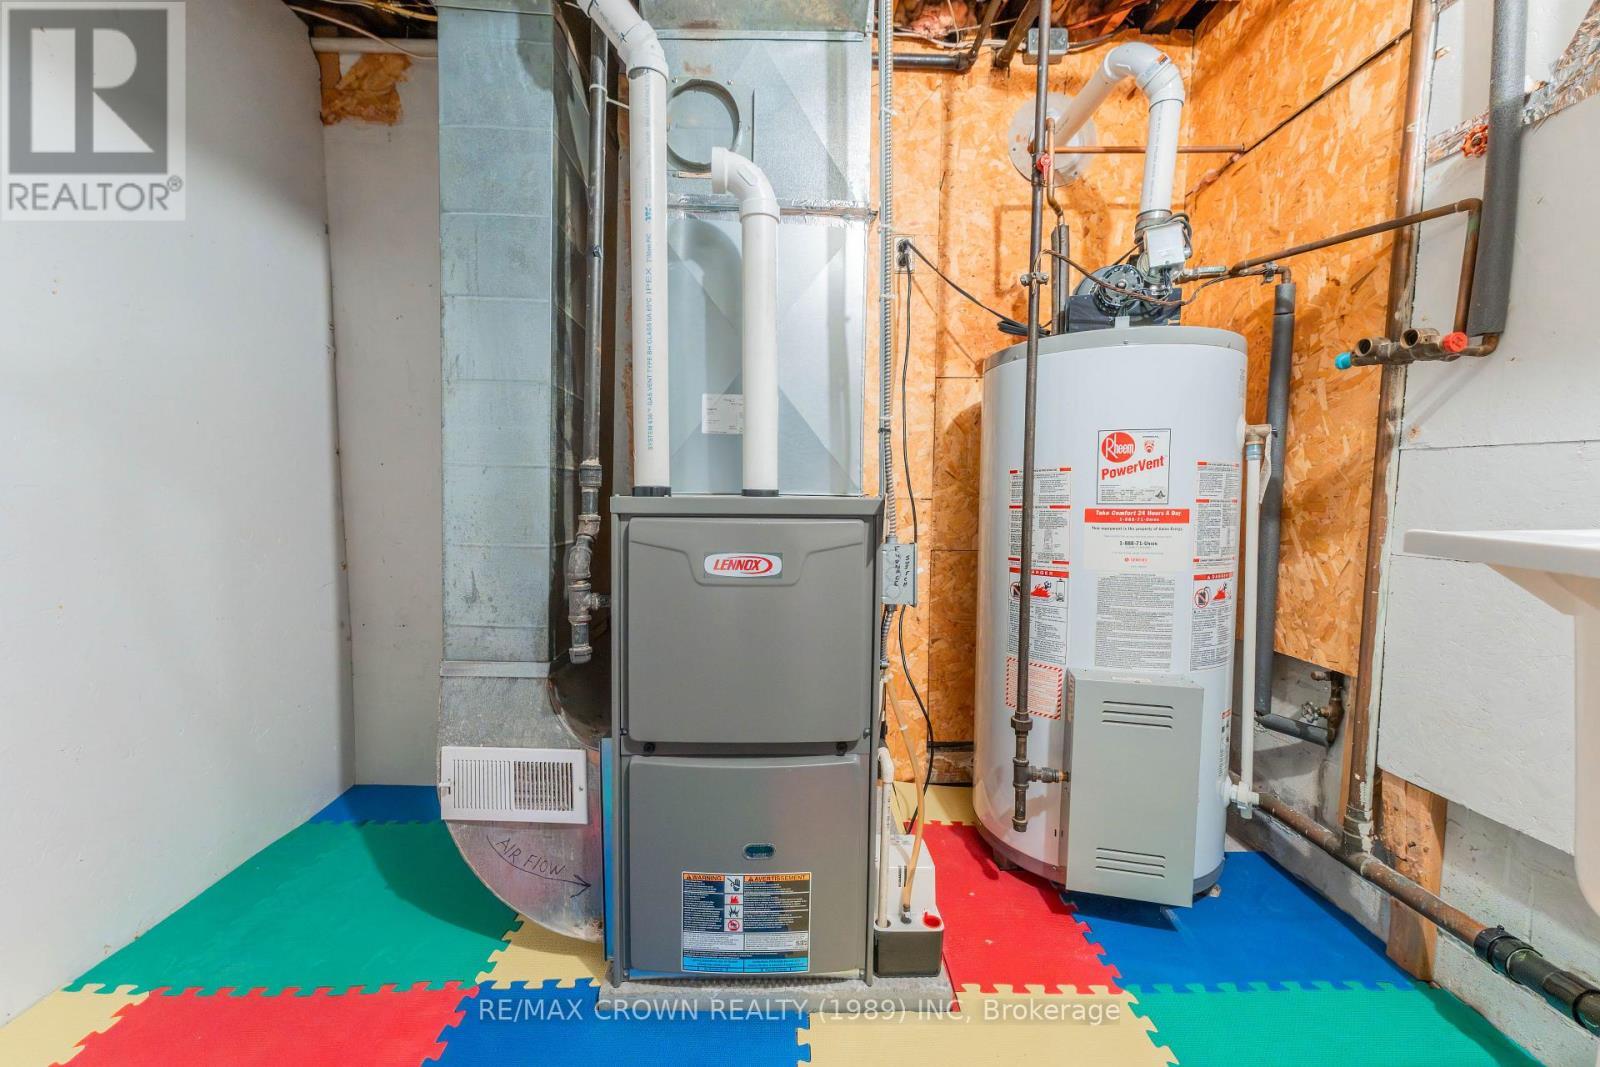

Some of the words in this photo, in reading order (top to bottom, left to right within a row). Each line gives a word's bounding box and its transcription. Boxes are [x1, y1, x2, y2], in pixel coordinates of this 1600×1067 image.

[1105, 432, 1134, 459] Rheem
[1101, 455, 1164, 480] PowerVent
[713, 559, 762, 571] LENNOX
[495, 837, 522, 863] AIR
